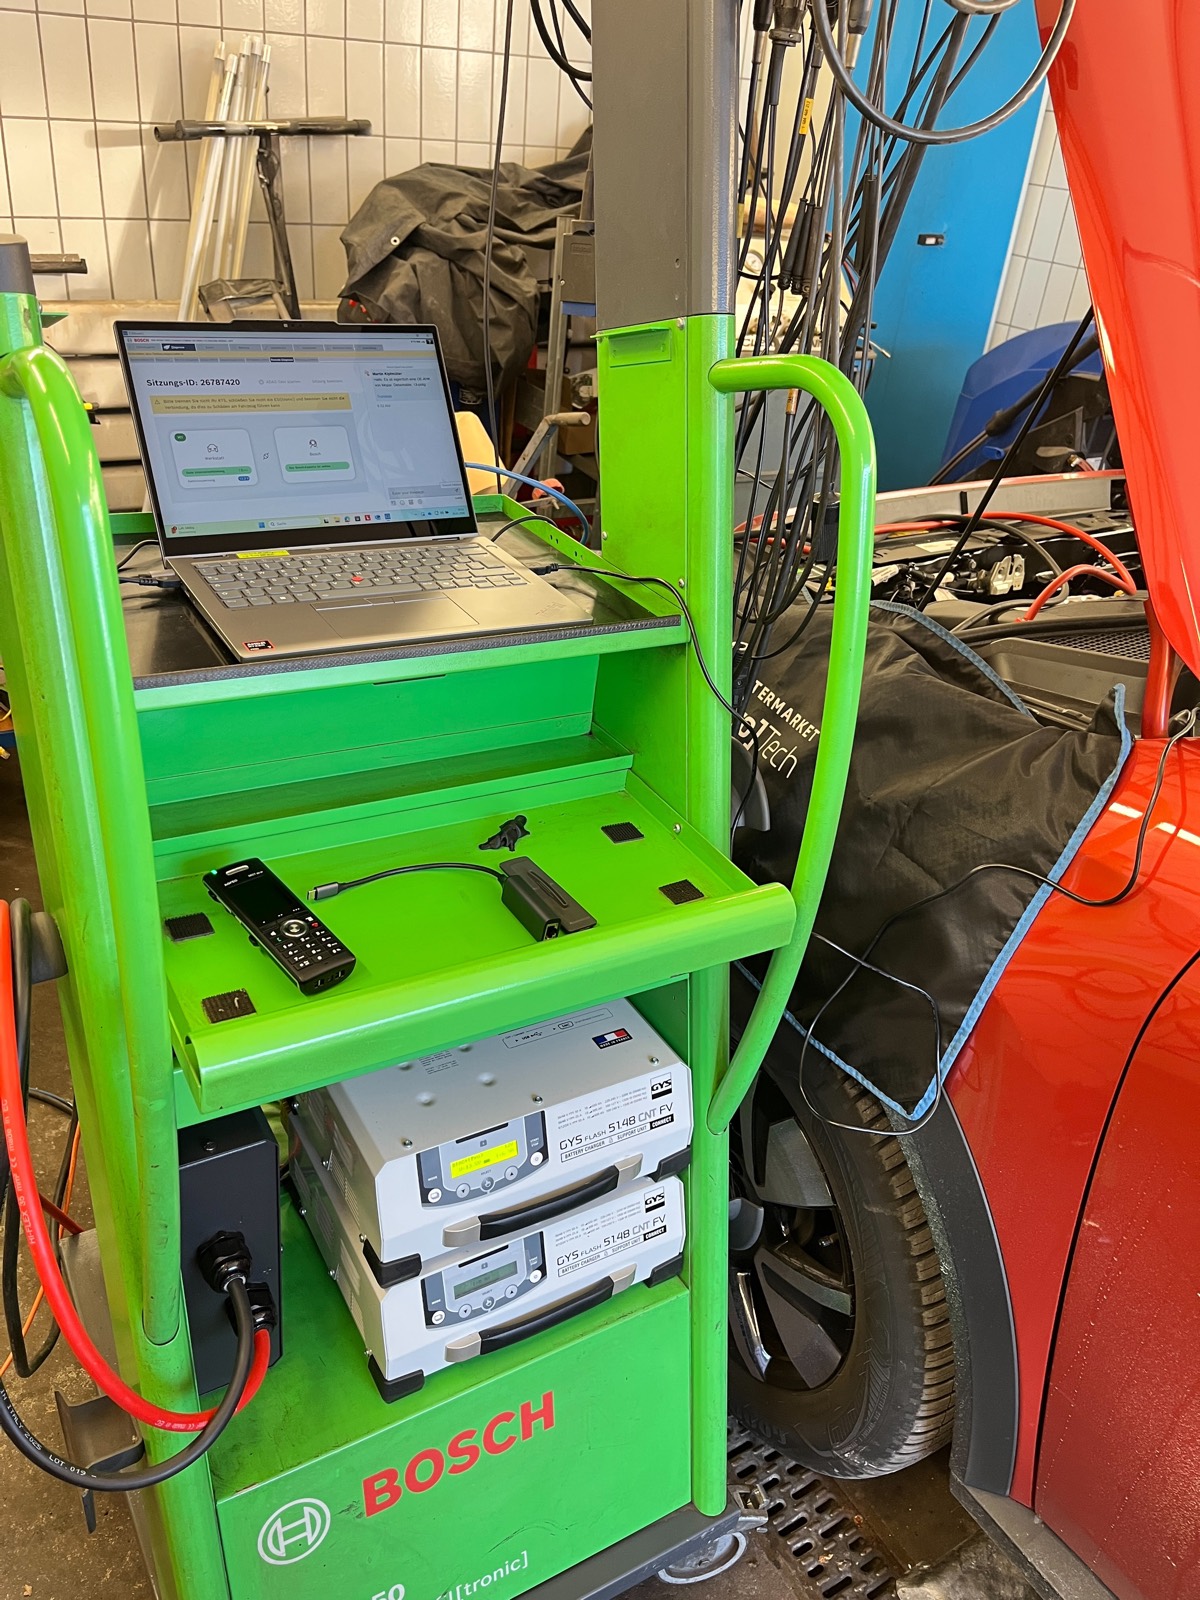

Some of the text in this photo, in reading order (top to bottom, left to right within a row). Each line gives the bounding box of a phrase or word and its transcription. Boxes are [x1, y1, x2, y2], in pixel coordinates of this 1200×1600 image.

[146, 379, 199, 388] Sitzungs-ID:
[752, 680, 820, 742] TERMARKET
[651, 1079, 671, 1091] GYS
[560, 1134, 582, 1150] GYS
[584, 1130, 606, 1141] FLASH
[638, 1108, 656, 1122] CNT
[660, 1102, 673, 1114] FV
[565, 1148, 583, 1159] BATTERY
[584, 1141, 605, 1152] CHARGER
[617, 1129, 636, 1140] SUPPORT
[652, 1116, 672, 1128] CONNECT
[645, 1193, 664, 1205] GYS
[557, 1250, 578, 1266] GYS
[581, 1244, 601, 1256] FLASH
[632, 1221, 650, 1235] CNT
[652, 1214, 666, 1226] FV
[562, 1263, 580, 1273] BATTERY
[581, 1255, 600, 1265] CHARGER
[612, 1242, 630, 1253] SUPPORT
[646, 1227, 665, 1239] CONNECT
[7, 1405, 24, 1429] ITALY
[362, 1390, 555, 1518] BOSCH
